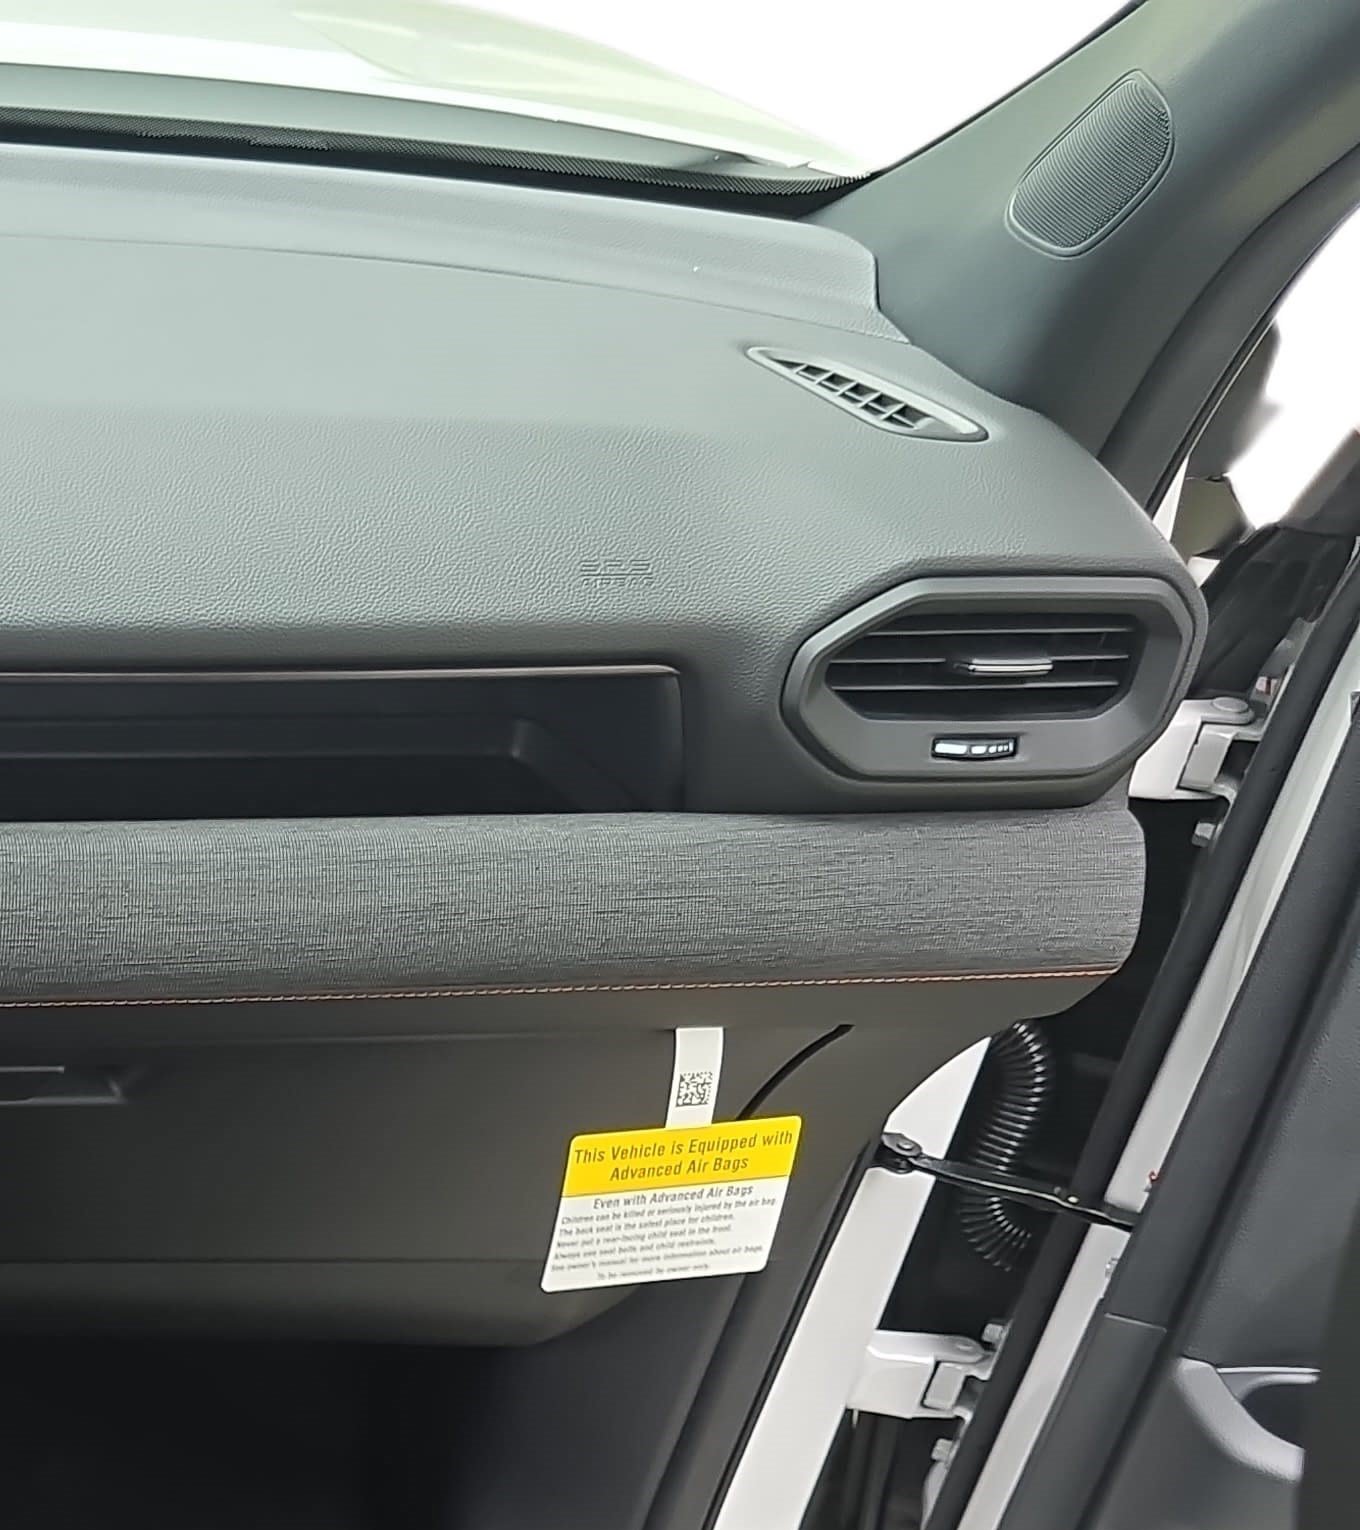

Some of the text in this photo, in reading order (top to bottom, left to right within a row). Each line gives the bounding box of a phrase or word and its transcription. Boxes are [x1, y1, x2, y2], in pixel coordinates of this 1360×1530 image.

[575, 1130, 793, 1164] This Vehicle is Equipped with
[610, 1157, 749, 1181] Advanced Air Bags
[593, 1185, 754, 1209] Even with Advanced Air Bags
